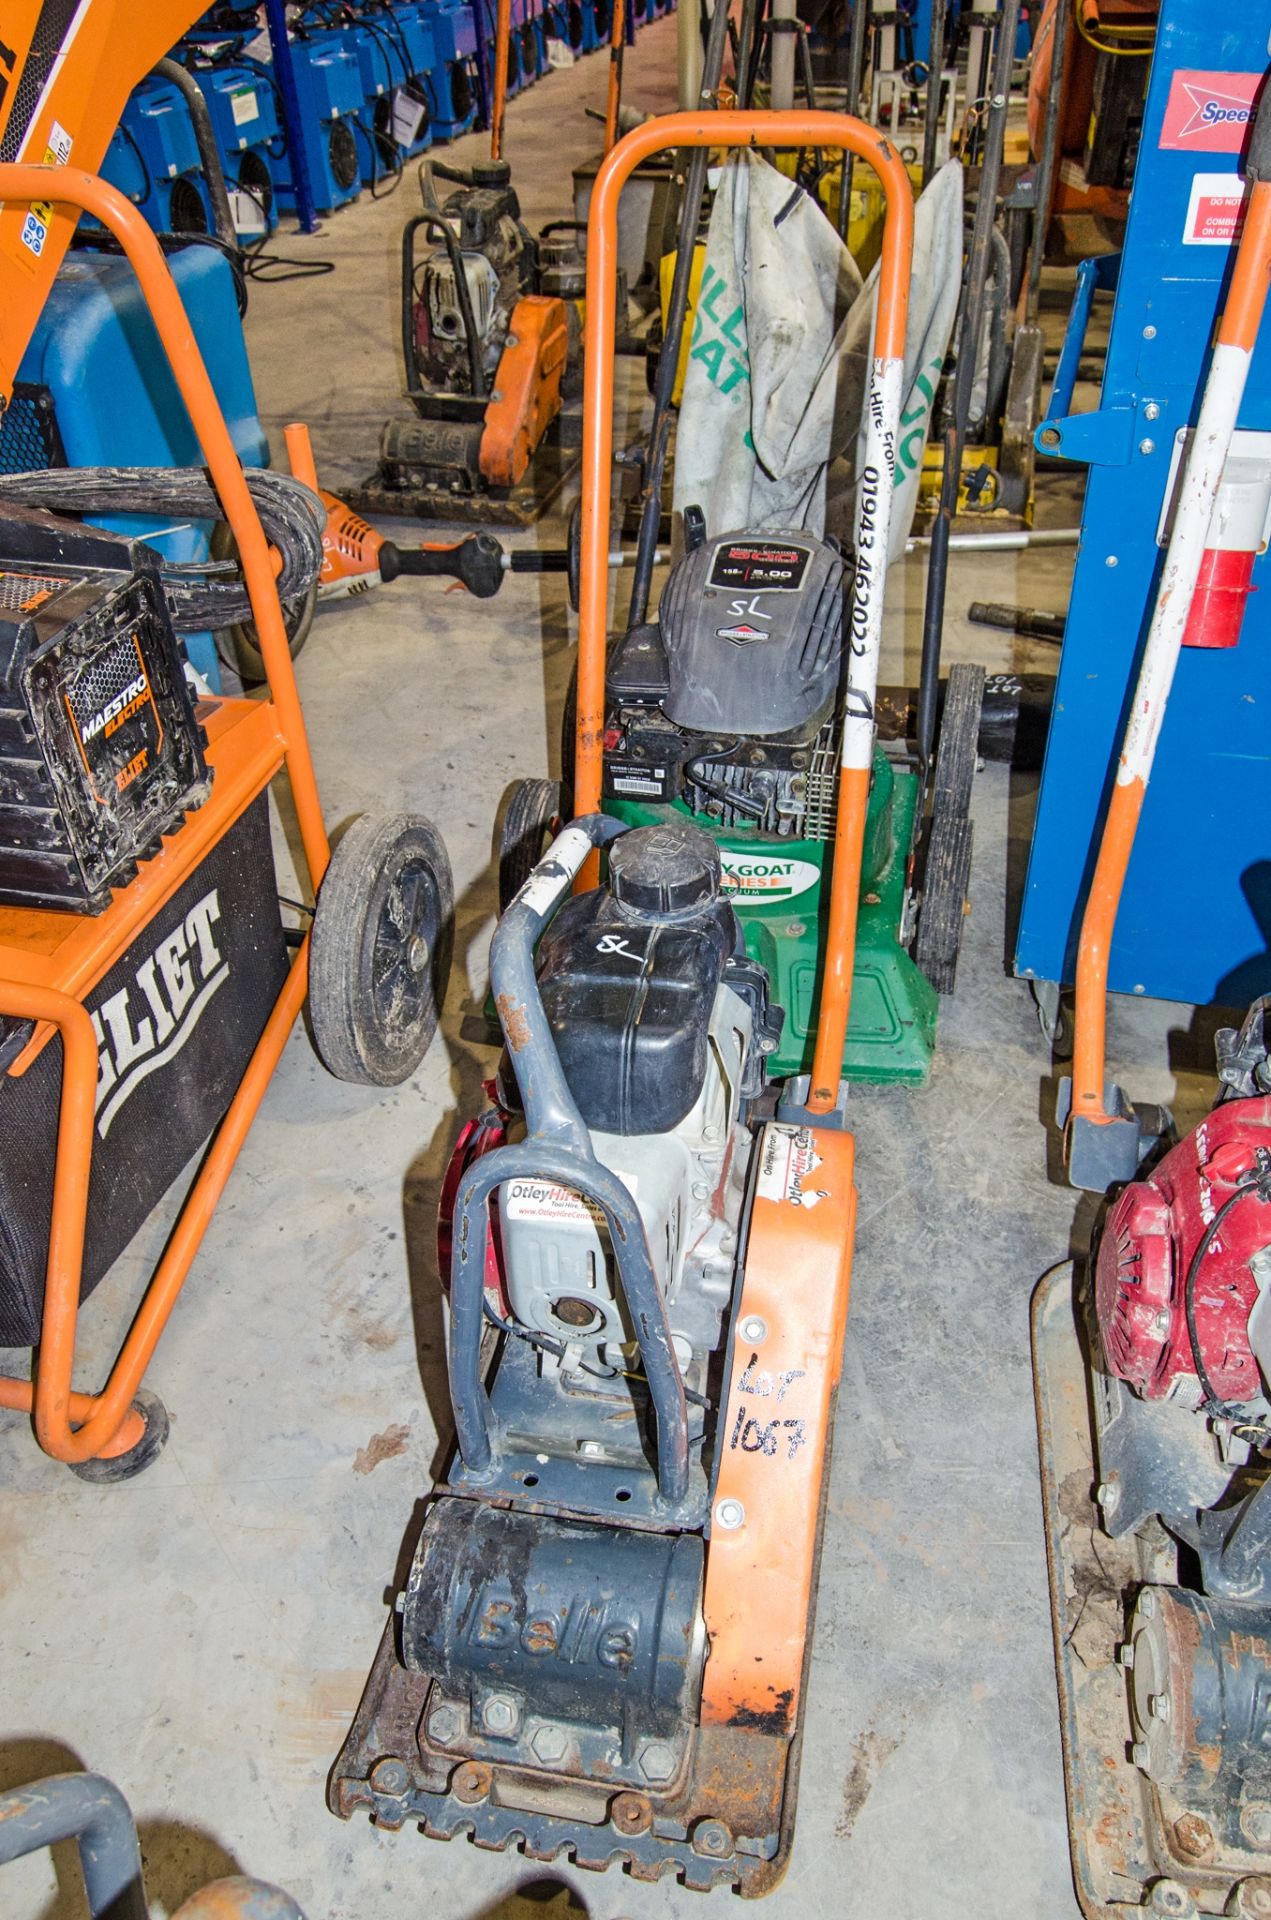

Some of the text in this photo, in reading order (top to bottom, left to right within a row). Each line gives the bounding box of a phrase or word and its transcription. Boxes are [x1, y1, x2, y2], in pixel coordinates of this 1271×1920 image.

[1210, 198, 1242, 206] DO NOT
[1202, 228, 1215, 236] ON
[1217, 228, 1229, 236] OR
[869, 392, 884, 430] Hire
[861, 465, 880, 549] 01943
[753, 569, 792, 578] 5.00
[726, 595, 773, 620] SL
[81, 673, 148, 745] MAESTRO
[104, 685, 151, 739] ELECTRO
[114, 746, 149, 793] ELIET
[738, 863, 795, 877] GOAT
[737, 1352, 806, 1402] LOT
[730, 1406, 807, 1459] 1067
[468, 1588, 640, 1676] Belle
